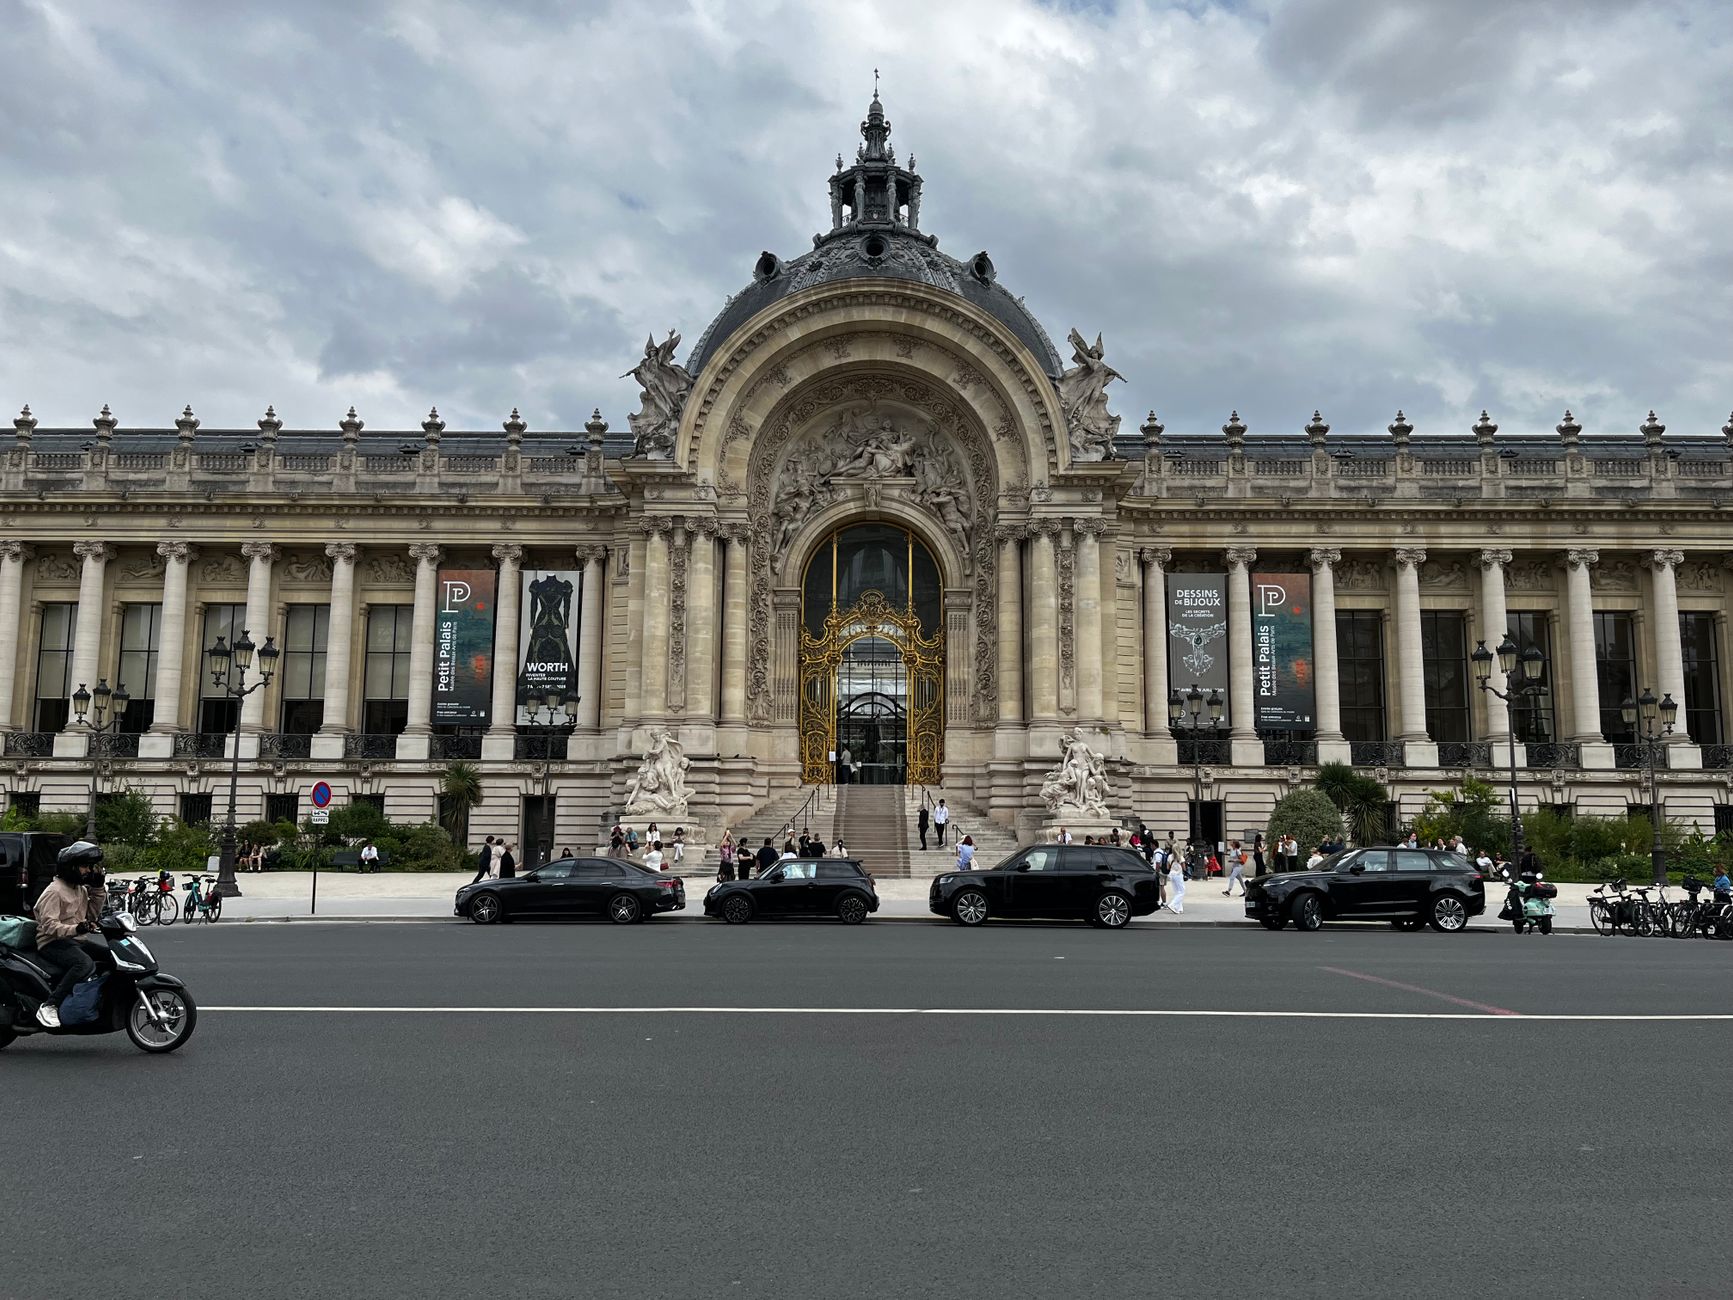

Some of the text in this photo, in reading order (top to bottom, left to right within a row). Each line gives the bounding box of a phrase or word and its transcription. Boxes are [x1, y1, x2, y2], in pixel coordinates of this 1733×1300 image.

[1176, 590, 1218, 598] DESSINS
[1184, 598, 1220, 606] BIJOUX
[440, 621, 452, 657] Palais
[527, 662, 568, 672] WORTH
[1258, 625, 1271, 696] Petit Palais
[438, 661, 450, 691] Petit
